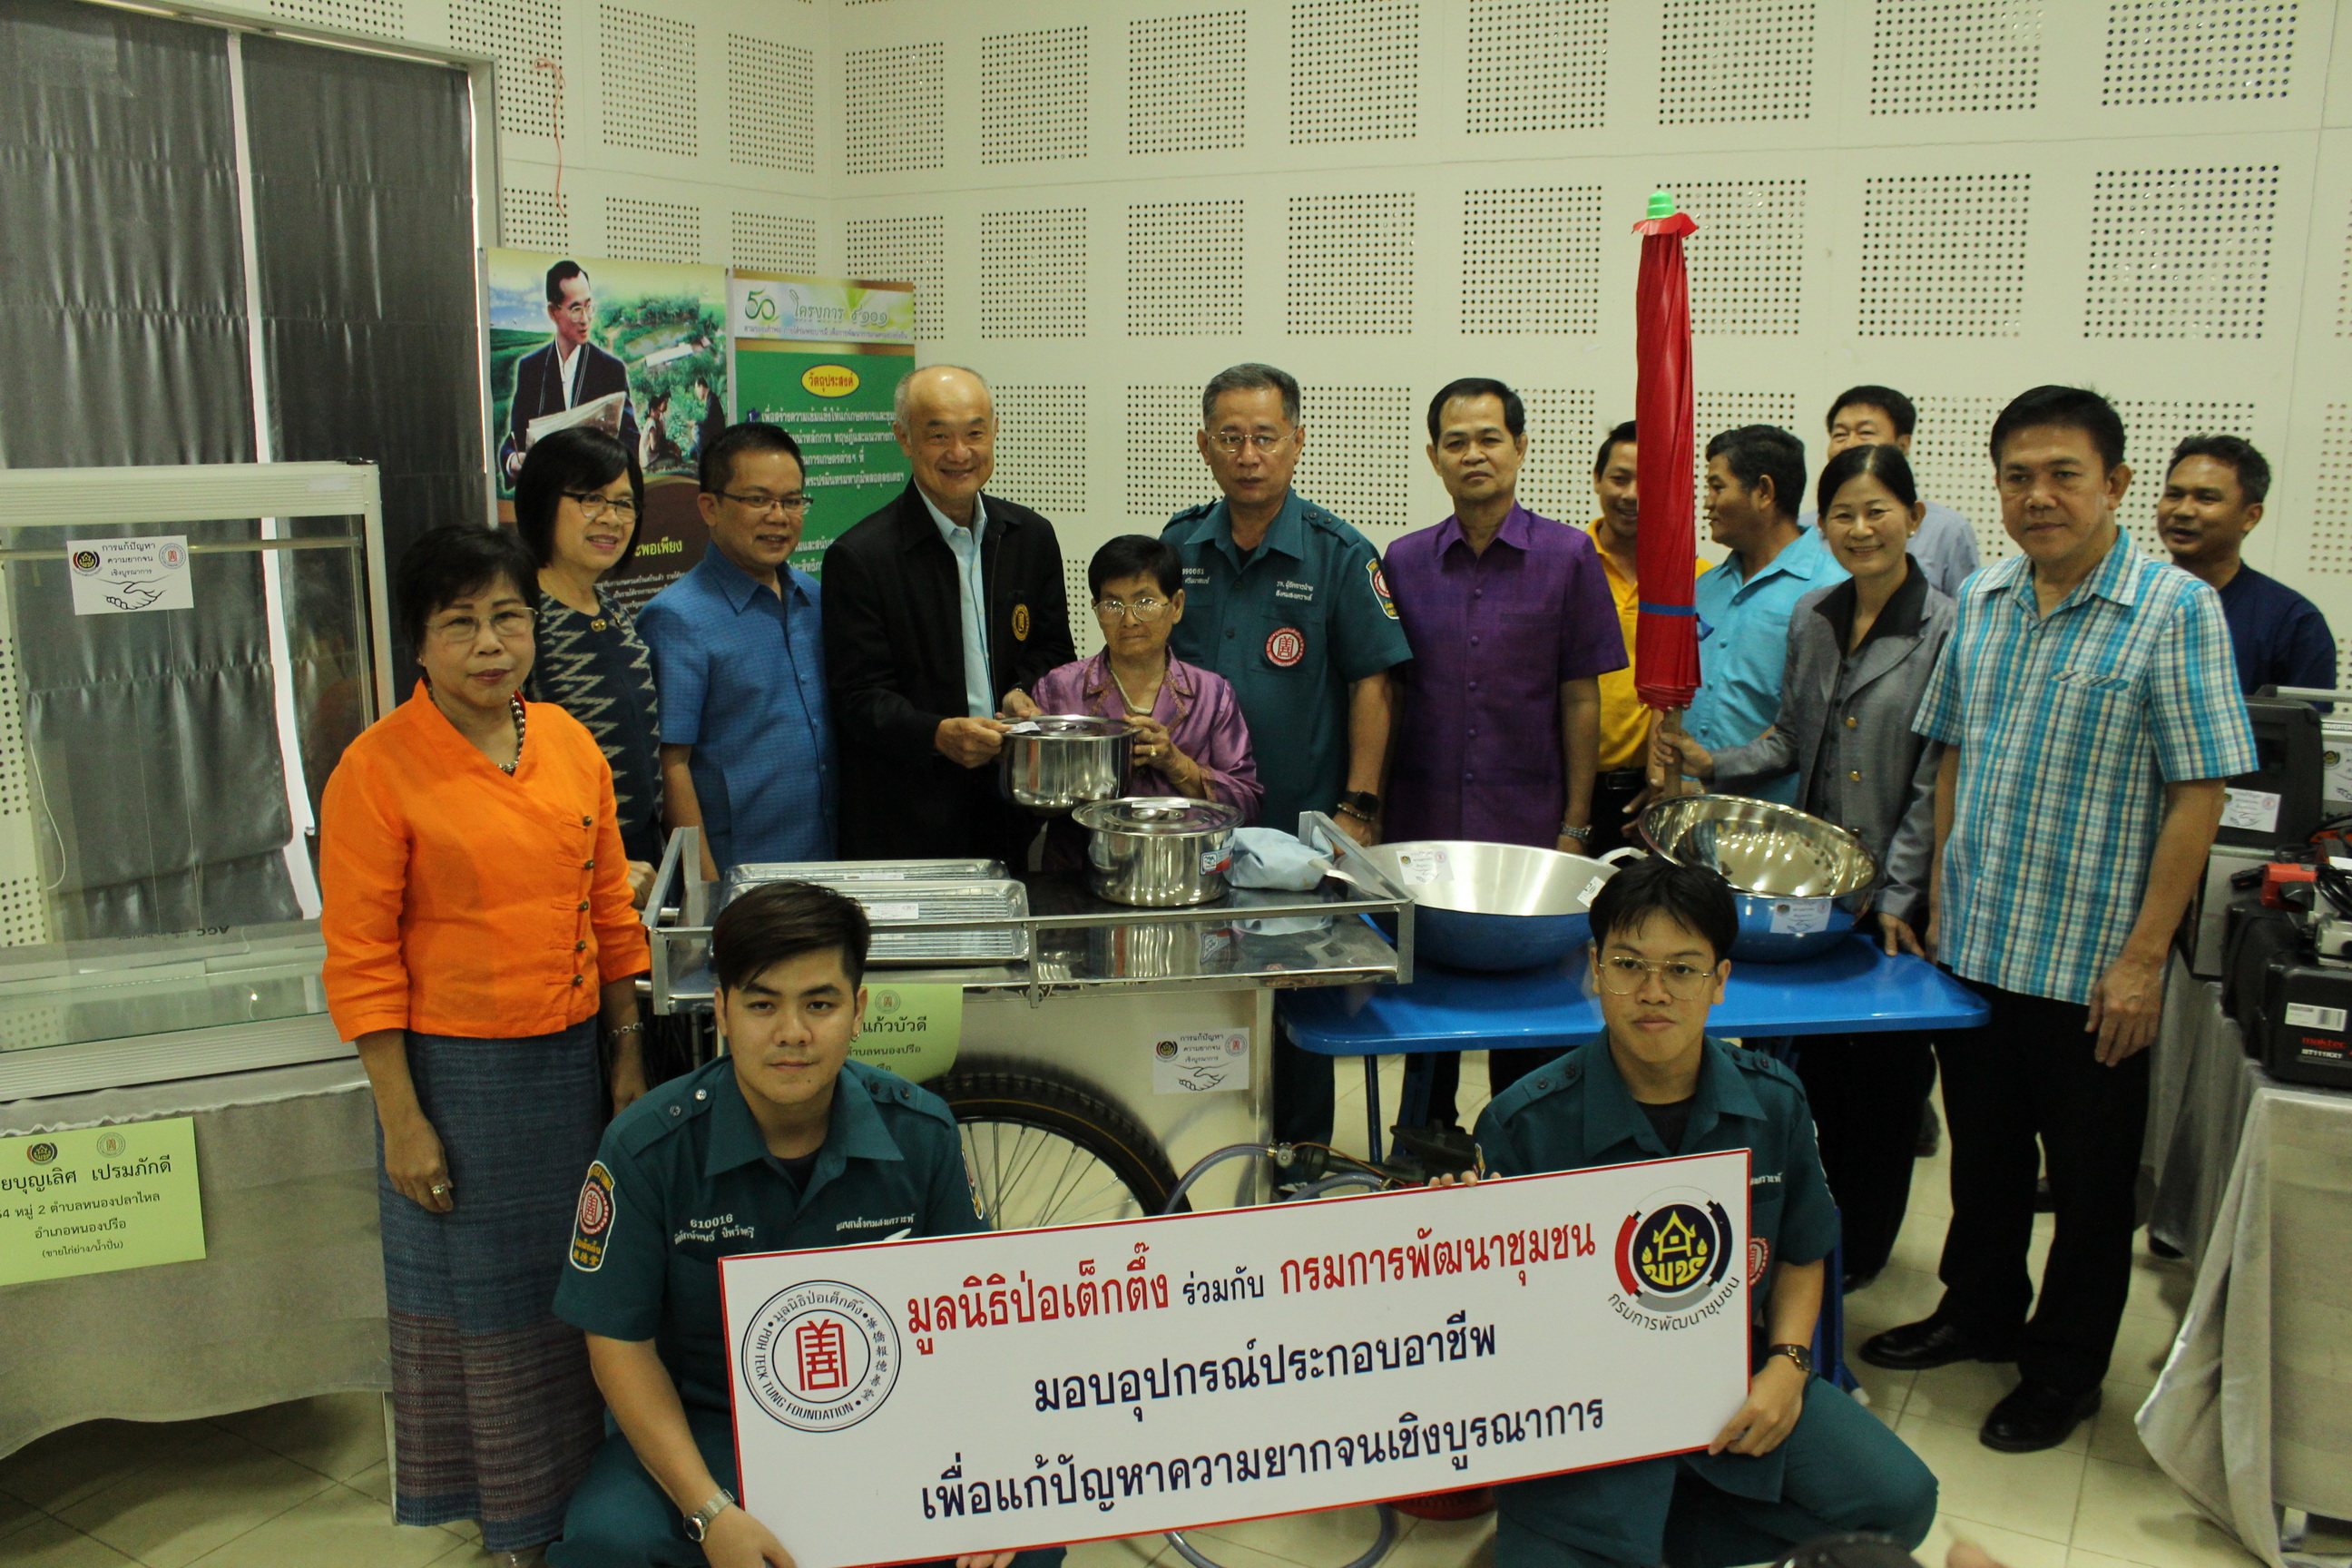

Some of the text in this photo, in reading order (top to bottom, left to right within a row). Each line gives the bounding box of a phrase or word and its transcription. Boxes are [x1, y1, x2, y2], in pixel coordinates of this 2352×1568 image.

[808, 371, 854, 392] วัตถุประสงค์
[102, 541, 156, 553] การแก้ปัญหา
[107, 556, 153, 564] ความยากจน
[862, 1015, 927, 1033] แก้วบัวดี
[92, 1154, 172, 1181] เปรมภักดี
[15, 1204, 34, 1220] หมู่
[38, 1204, 45, 1215] 2
[50, 1191, 161, 1213] ตำบลหนองปลาไหล
[34, 1217, 127, 1240] อำเภอหนองปรือ
[690, 1213, 733, 1229] 610016
[907, 1221, 1596, 1355] มูลนิธิป่อเต็กตึ๊ง ร่วมกับ กรมการพัฒนาชุมชน
[1608, 1276, 1740, 1331] กรมการพัฒนาชุมชน
[755, 1328, 855, 1421] POH TECK TUNG FOUNDATION
[1034, 1310, 1497, 1422] มอบอุปกรณ์ประกอบอาชีพ
[922, 1397, 1604, 1519] เพื่อแก้ปัญหาความยากจนเชิงบูรณาการ
